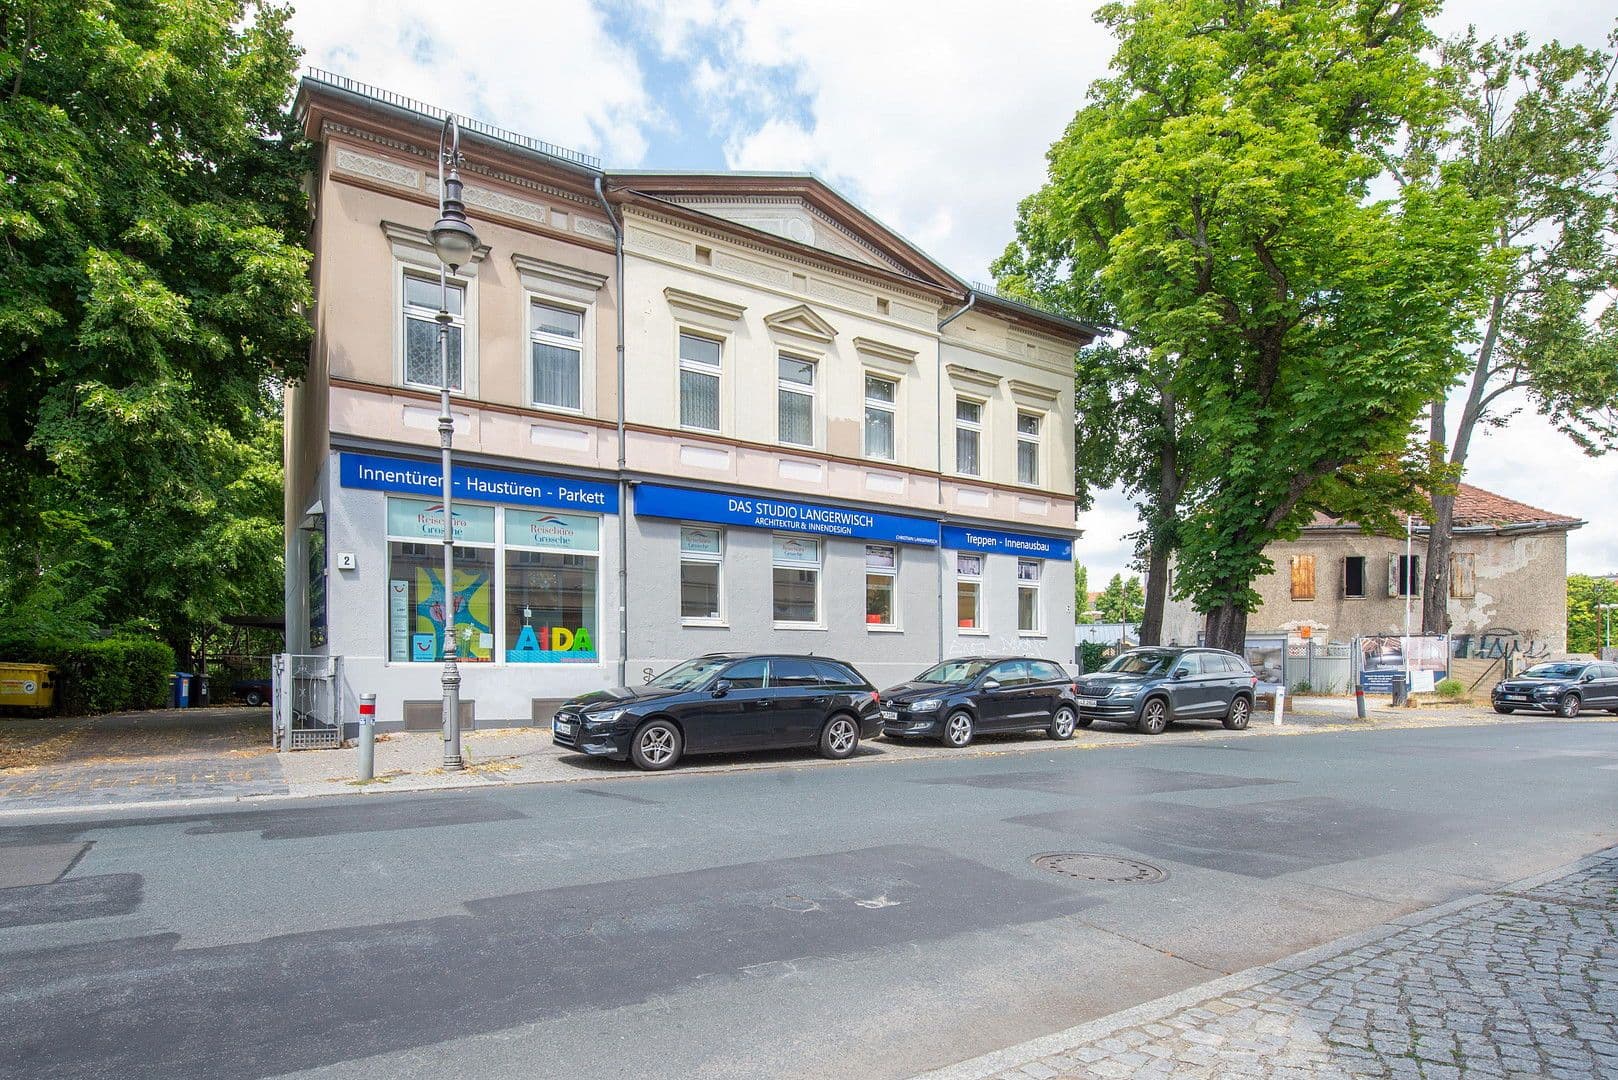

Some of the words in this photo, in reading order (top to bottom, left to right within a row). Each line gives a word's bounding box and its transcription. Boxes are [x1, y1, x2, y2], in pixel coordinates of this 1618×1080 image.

[467, 477, 541, 497] Haustüren
[559, 487, 605, 504] Parkett
[417, 513, 467, 527] Reiseüro
[728, 499, 752, 513] DAS
[756, 503, 797, 518] STUDIO
[800, 508, 873, 527] LANGERWISCH
[422, 524, 463, 536] Grose
[755, 517, 800, 529] ARCHITEKTUR
[800, 521, 807, 529] &
[808, 523, 852, 534] INNENDESIGN
[966, 533, 997, 547] Treppen
[1005, 538, 1049, 552] Innenausbau
[344, 556, 350, 566] 2
[515, 625, 592, 651] AIDA
